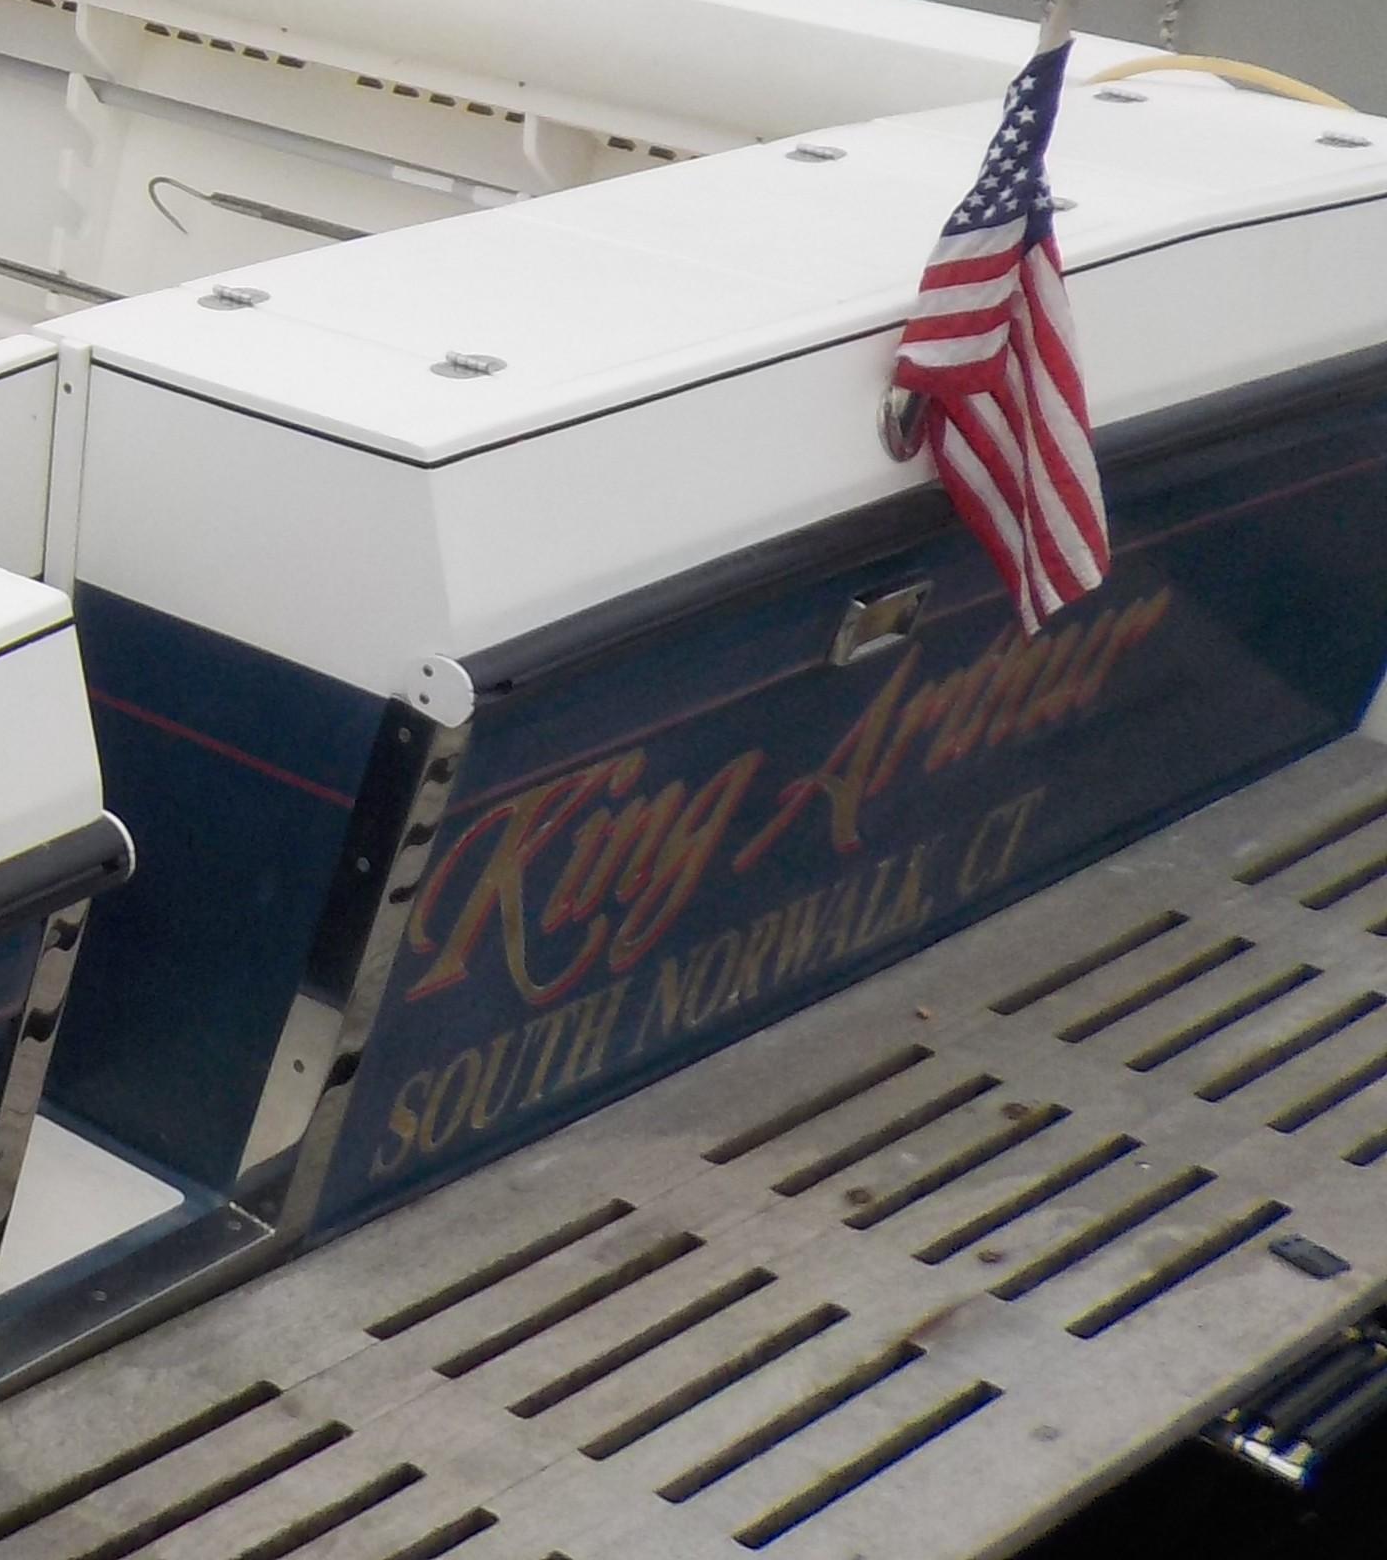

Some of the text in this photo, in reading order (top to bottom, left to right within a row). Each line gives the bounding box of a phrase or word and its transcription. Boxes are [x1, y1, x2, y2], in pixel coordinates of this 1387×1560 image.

[369, 785, 1049, 1182] SOUTH NORWALK CT
[405, 586, 1171, 1007] King Arthur
